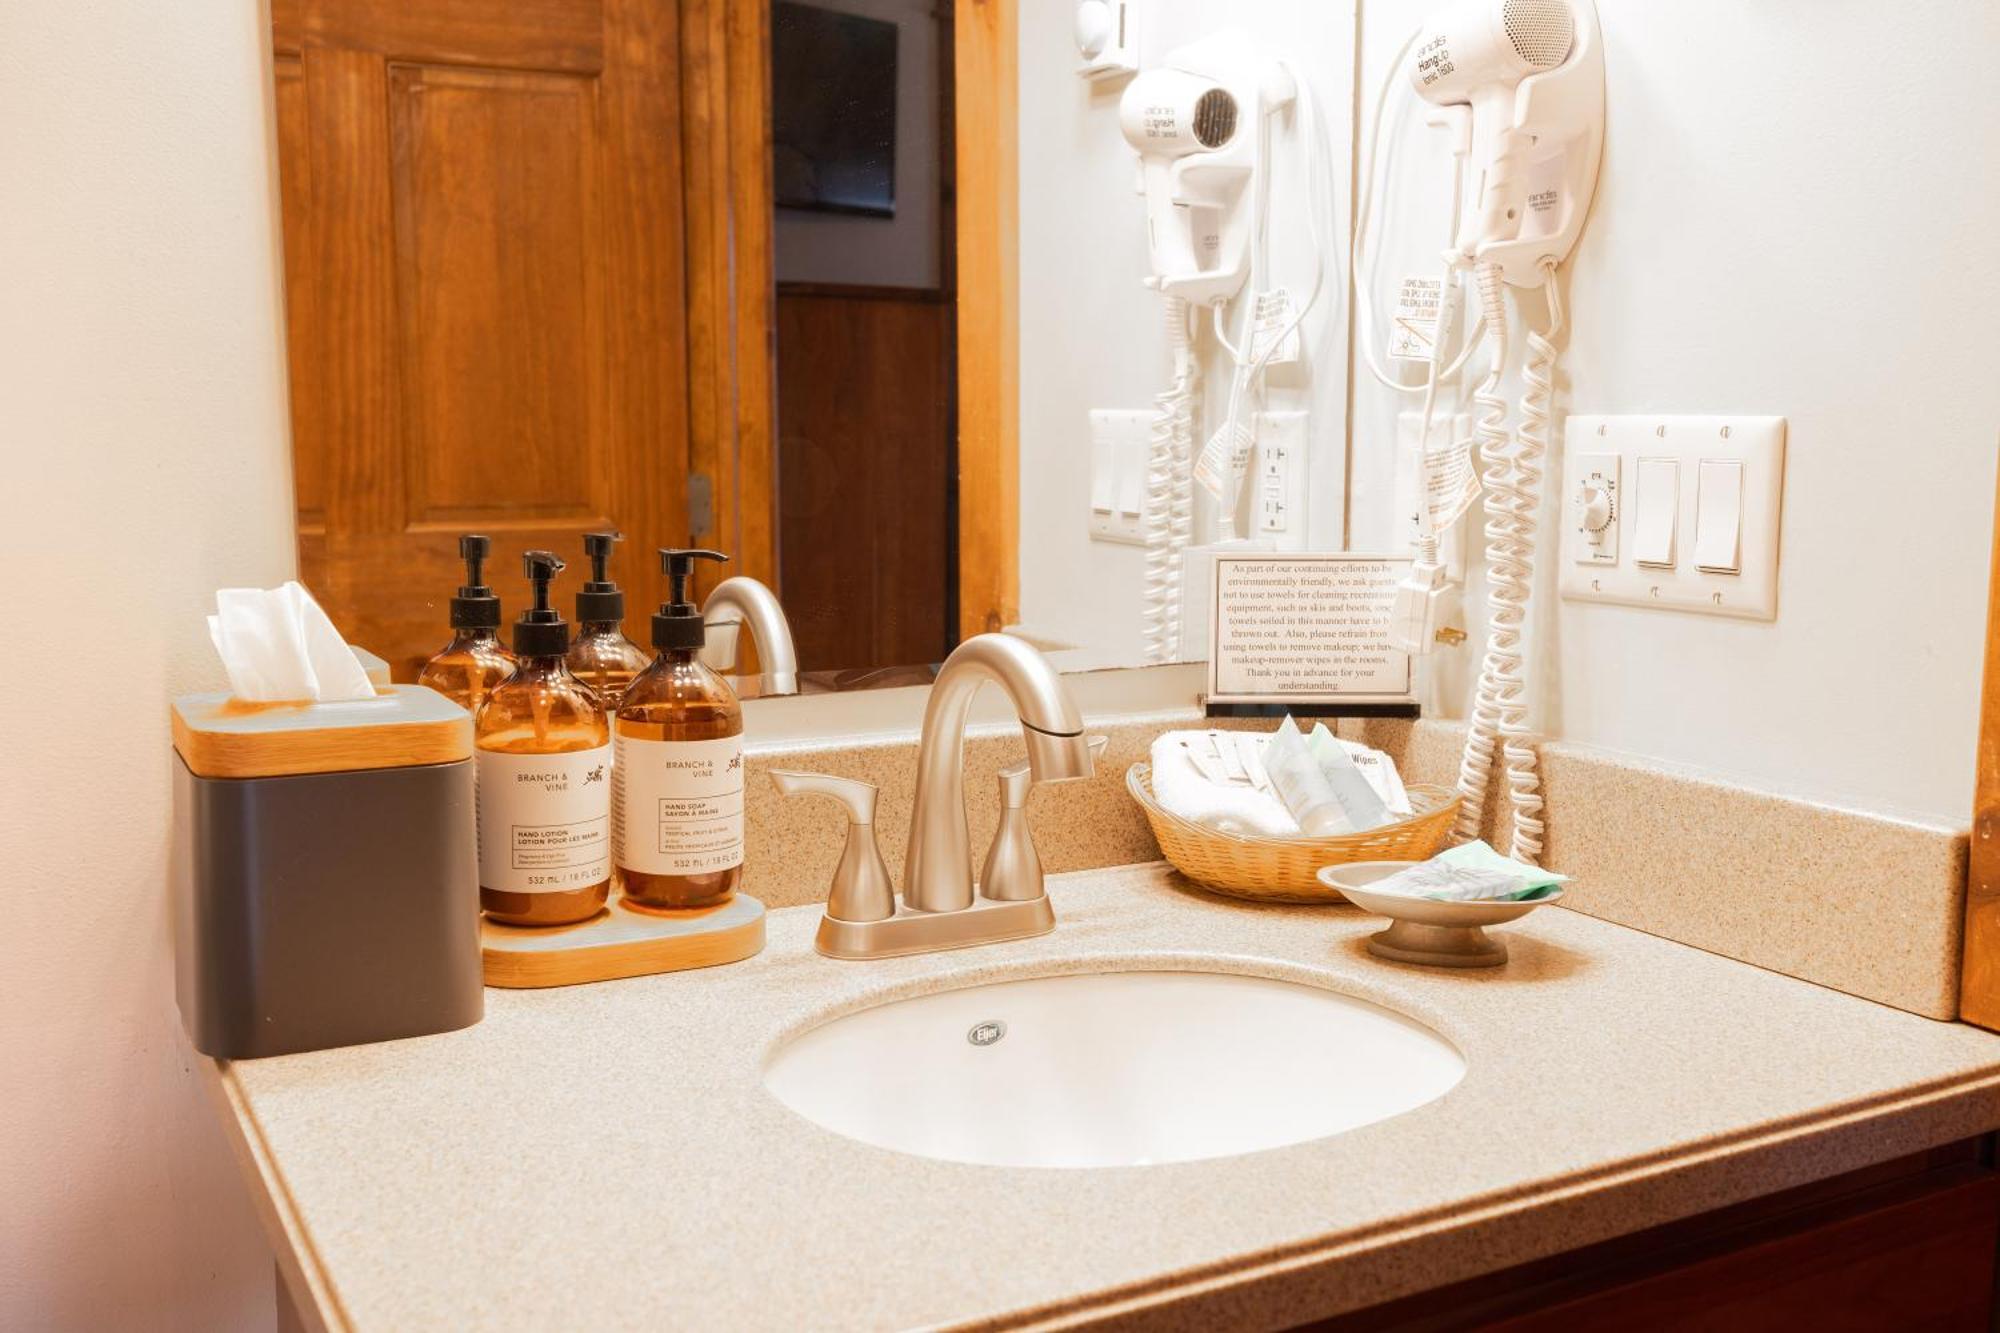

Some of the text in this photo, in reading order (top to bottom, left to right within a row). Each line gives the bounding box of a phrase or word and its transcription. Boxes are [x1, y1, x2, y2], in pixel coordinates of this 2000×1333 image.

[1233, 565, 1245, 575] As
[1246, 565, 1264, 575] part
[1266, 565, 1275, 575] of
[1278, 565, 1291, 575] our
[1294, 565, 1339, 575] continuing
[1341, 565, 1368, 575] efforts
[1371, 565, 1380, 575] to
[1228, 577, 1297, 588] environmentally
[1300, 577, 1335, 588] friendly,
[1338, 577, 1349, 588] we
[1353, 577, 1366, 588] ask
[1224, 591, 1237, 600] not
[1239, 591, 1248, 600] to
[1251, 591, 1264, 600] use
[1267, 591, 1295, 600] towels
[1299, 591, 1309, 600] for
[1312, 591, 1349, 600] cleaning
[1227, 603, 1273, 613] equipment,
[1277, 603, 1297, 613] such
[1299, 603, 1308, 613] as
[1310, 603, 1325, 613] skis
[1329, 603, 1343, 613] and
[1347, 603, 1372, 613] boots,
[1229, 617, 1389, 625] towels soiled in this manner have to b
[1232, 630, 1261, 639] thrown
[1285, 630, 1307, 639] Also,
[1310, 630, 1335, 639] please
[1339, 630, 1367, 639] refrain
[1224, 643, 1245, 653] using
[1249, 643, 1276, 653] towels
[1280, 643, 1288, 653] to
[1290, 643, 1320, 653] remove
[1363, 643, 1378, 653] we
[1380, 643, 1392, 653] hav
[1232, 656, 1303, 666] makeup-remover
[1306, 656, 1330, 666] wipes
[1333, 656, 1341, 666] in
[1344, 656, 1355, 666] the
[1247, 669, 1375, 678] Thank you in advance for your
[517, 774, 558, 782] BRANCH
[723, 854, 730, 862] FL
[528, 876, 544, 884] 532
[582, 870, 590, 878] FL
